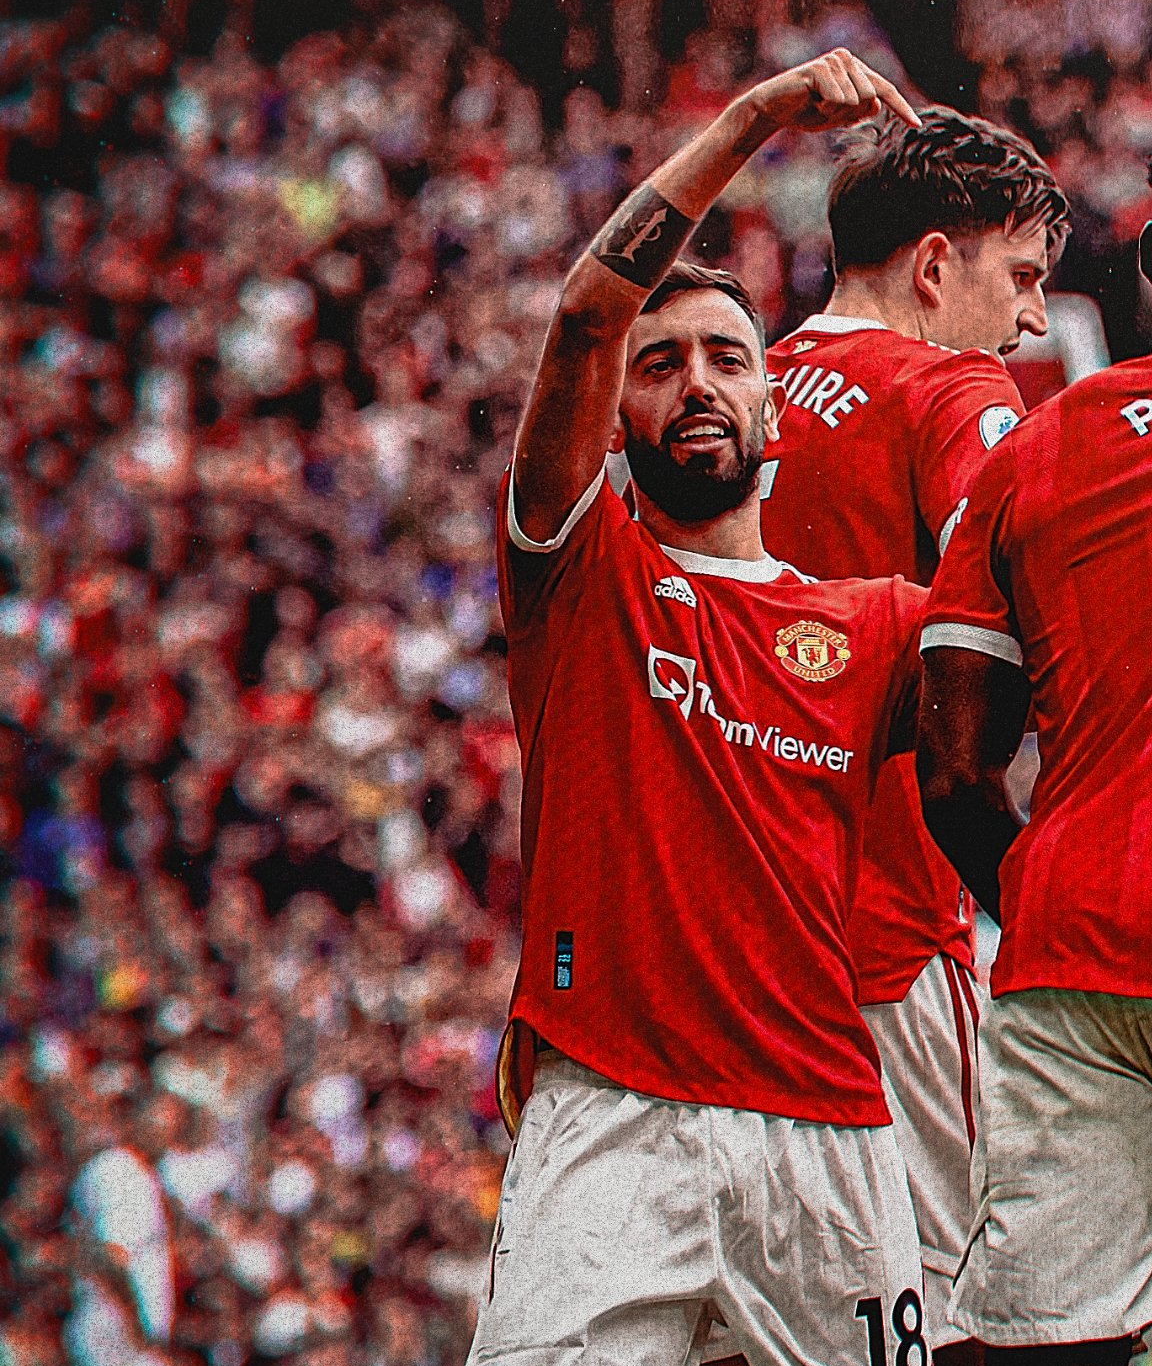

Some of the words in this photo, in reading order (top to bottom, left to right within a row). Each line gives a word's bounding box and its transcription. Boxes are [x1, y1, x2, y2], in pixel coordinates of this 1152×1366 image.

[767, 364, 870, 429] UIRE
[781, 624, 843, 645] MANCHESTER
[793, 665, 836, 678] UNITED
